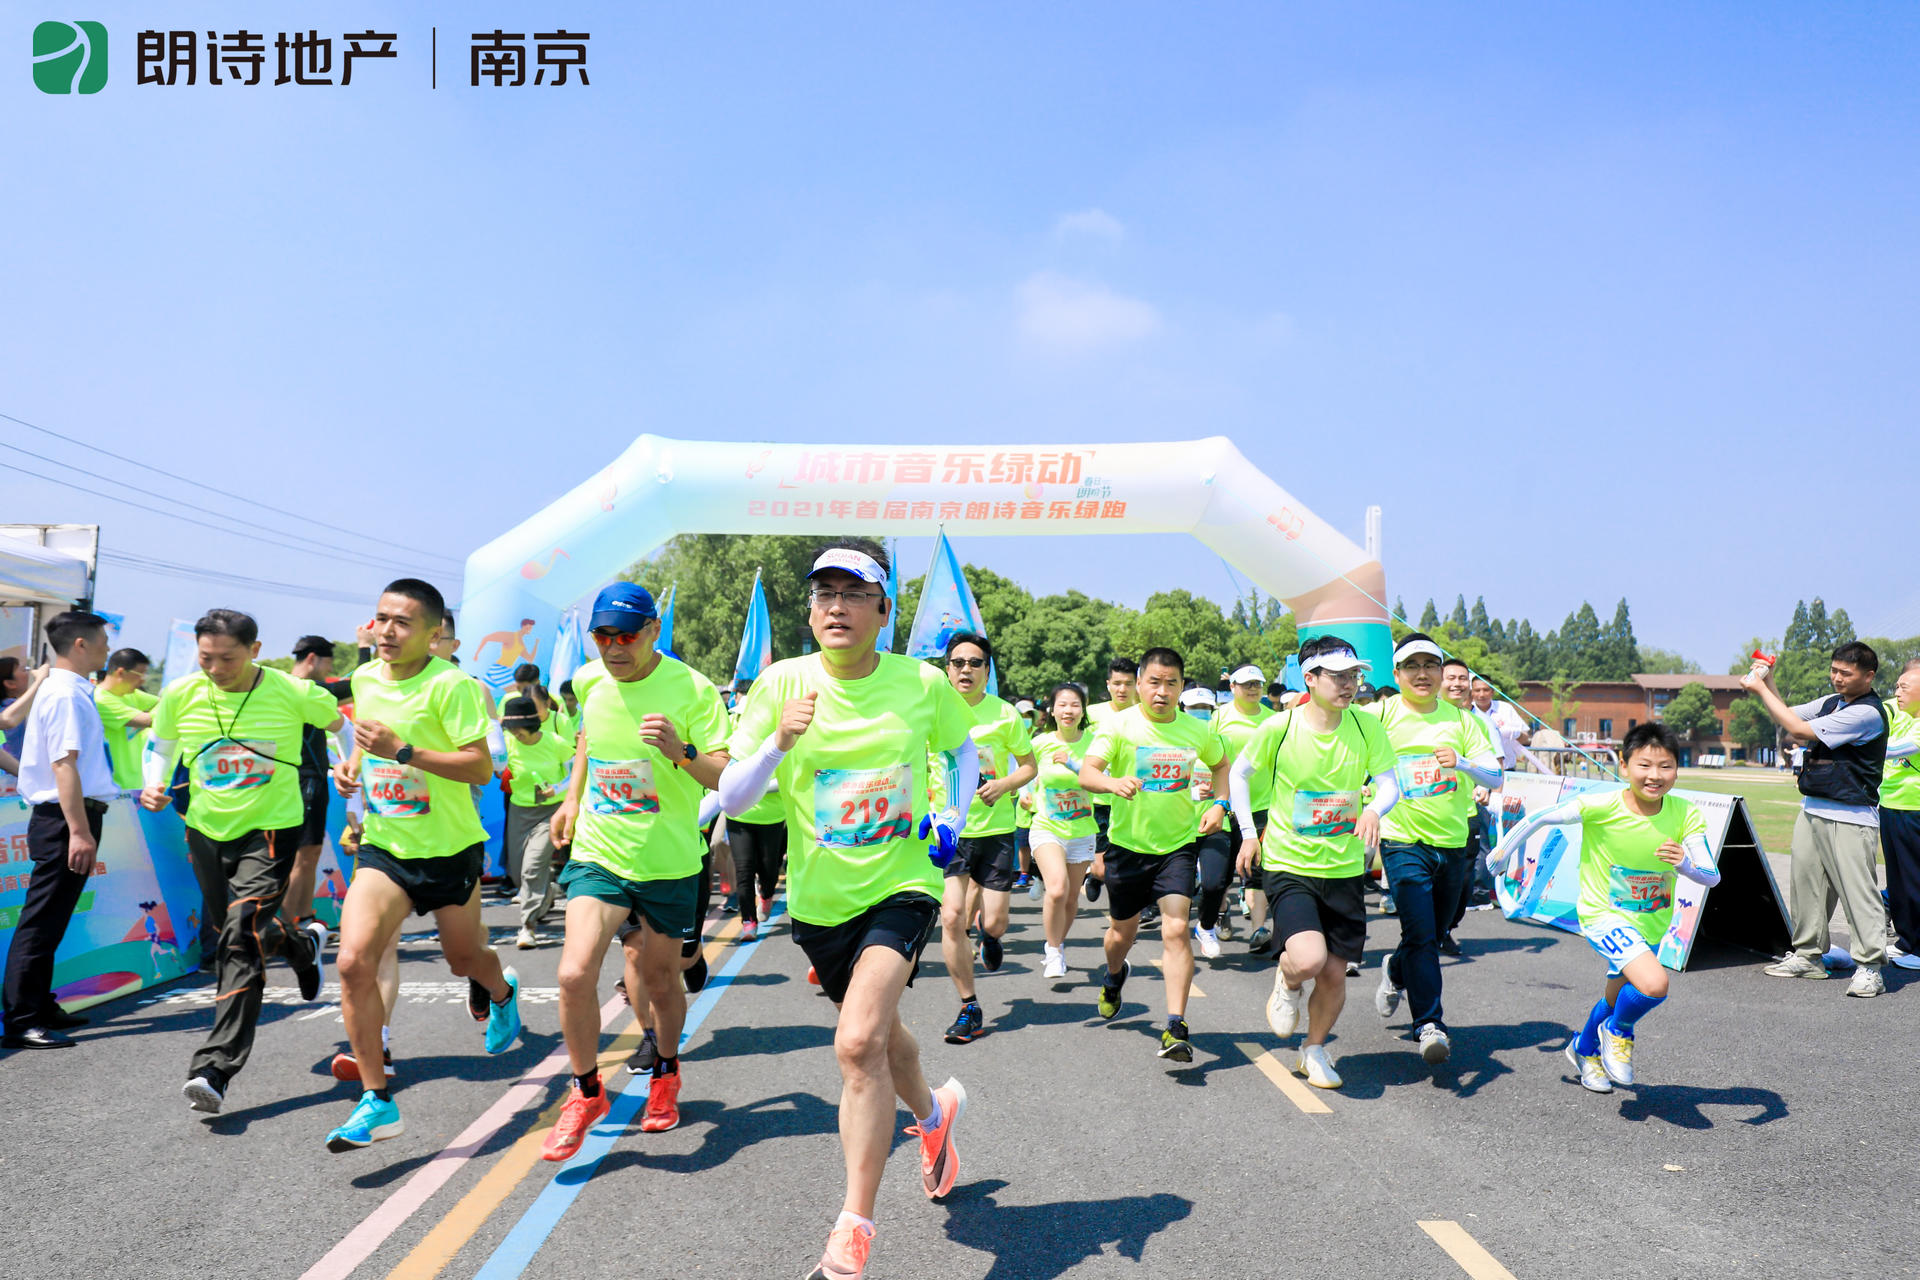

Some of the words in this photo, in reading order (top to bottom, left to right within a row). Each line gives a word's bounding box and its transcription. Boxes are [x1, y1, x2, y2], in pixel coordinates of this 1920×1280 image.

[794, 452, 1081, 484] 城市音乐绿动
[746, 499, 1127, 519] 2021年首届南京朗诗音乐绿跑
[217, 758, 255, 774] 019
[1151, 764, 1182, 779] 323
[1414, 768, 1441, 785] 550
[371, 782, 406, 801] 468
[840, 797, 889, 825] 219
[1058, 799, 1078, 812] 171
[1312, 809, 1343, 825] 534
[1631, 885, 1659, 900] 512
[1601, 927, 1634, 955] 43
